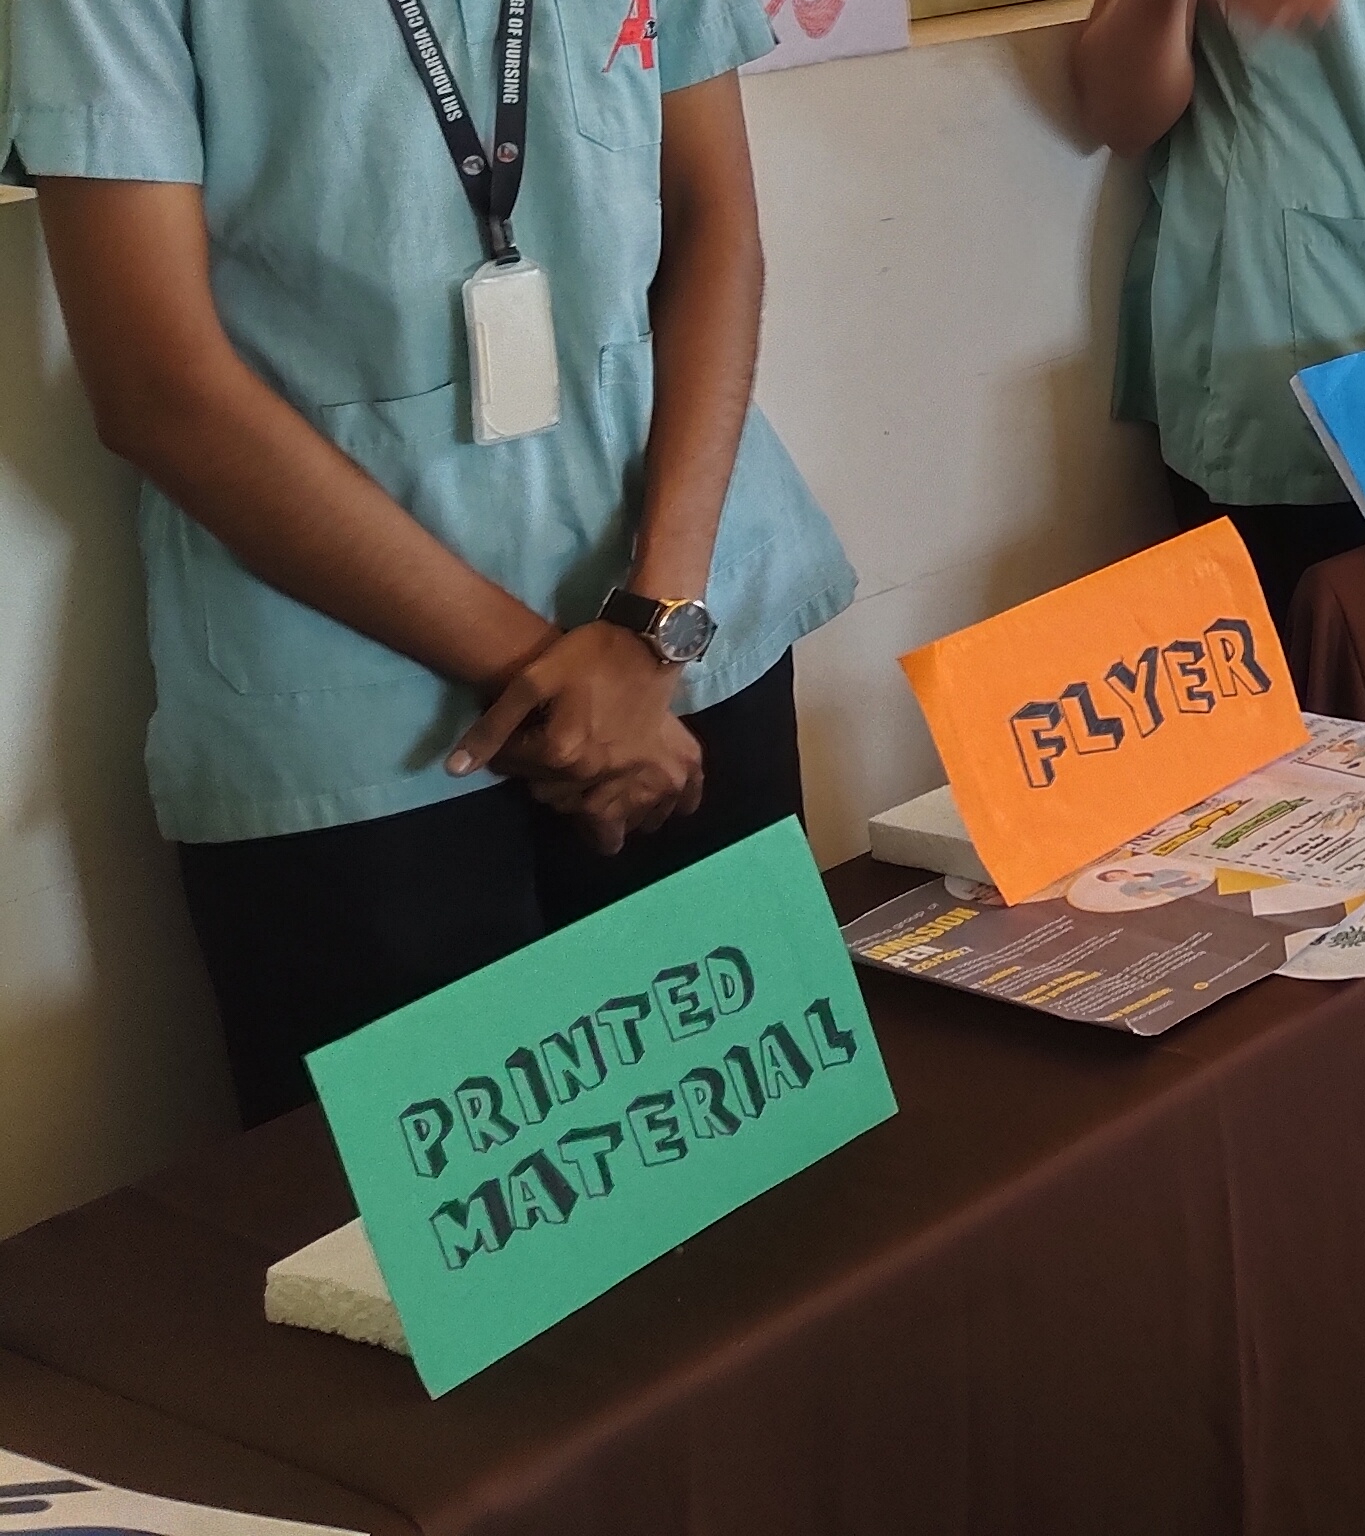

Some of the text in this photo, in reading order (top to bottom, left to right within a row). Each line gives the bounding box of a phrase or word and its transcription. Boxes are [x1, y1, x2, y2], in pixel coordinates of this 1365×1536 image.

[413, 27, 454, 94] ADARSHA
[508, 17, 524, 37] OF
[502, 37, 522, 104] NURSING
[441, 91, 463, 122] SRI
[1009, 617, 1273, 789] FLYER
[398, 945, 756, 1179] PRINTED
[429, 996, 858, 1271] MATERIAL
